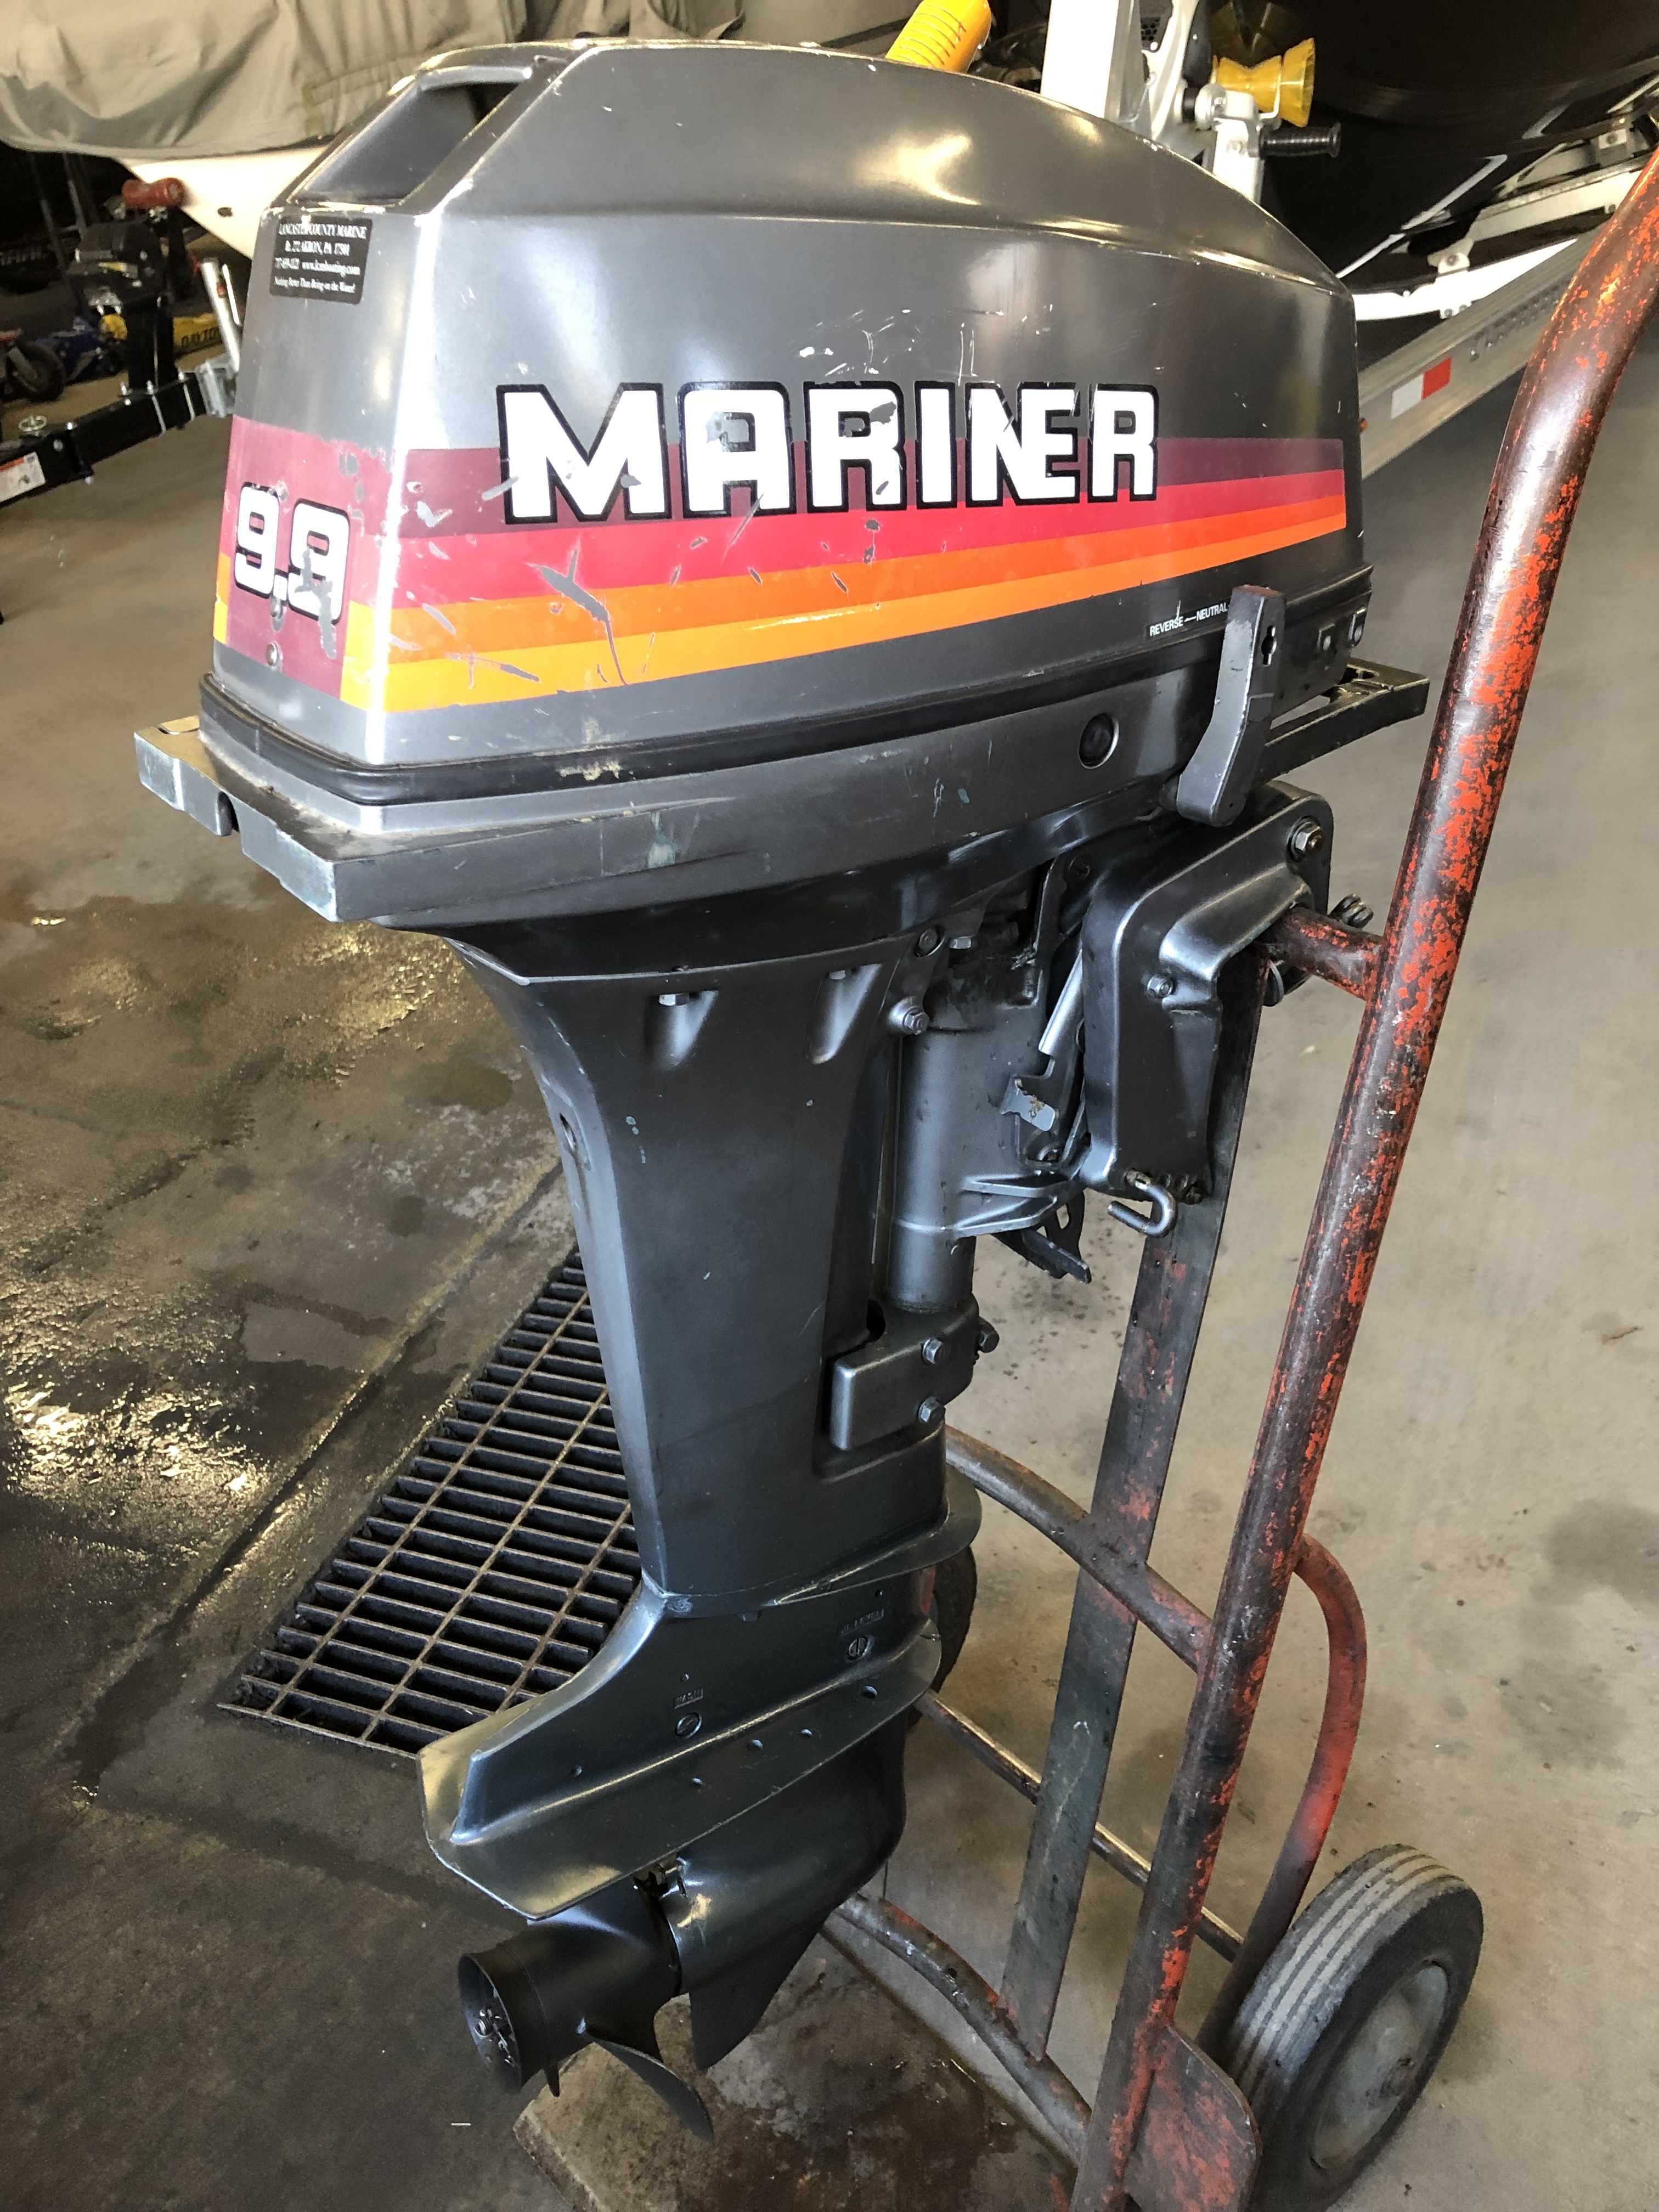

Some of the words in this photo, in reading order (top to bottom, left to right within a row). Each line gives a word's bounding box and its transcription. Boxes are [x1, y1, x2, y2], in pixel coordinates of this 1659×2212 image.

[336, 225, 367, 240] MARINE
[496, 380, 1160, 524] MARINER
[235, 481, 350, 625] 9.9
[1149, 616, 1184, 637] REVERSE
[1196, 602, 1228, 622] NEUTRAL
